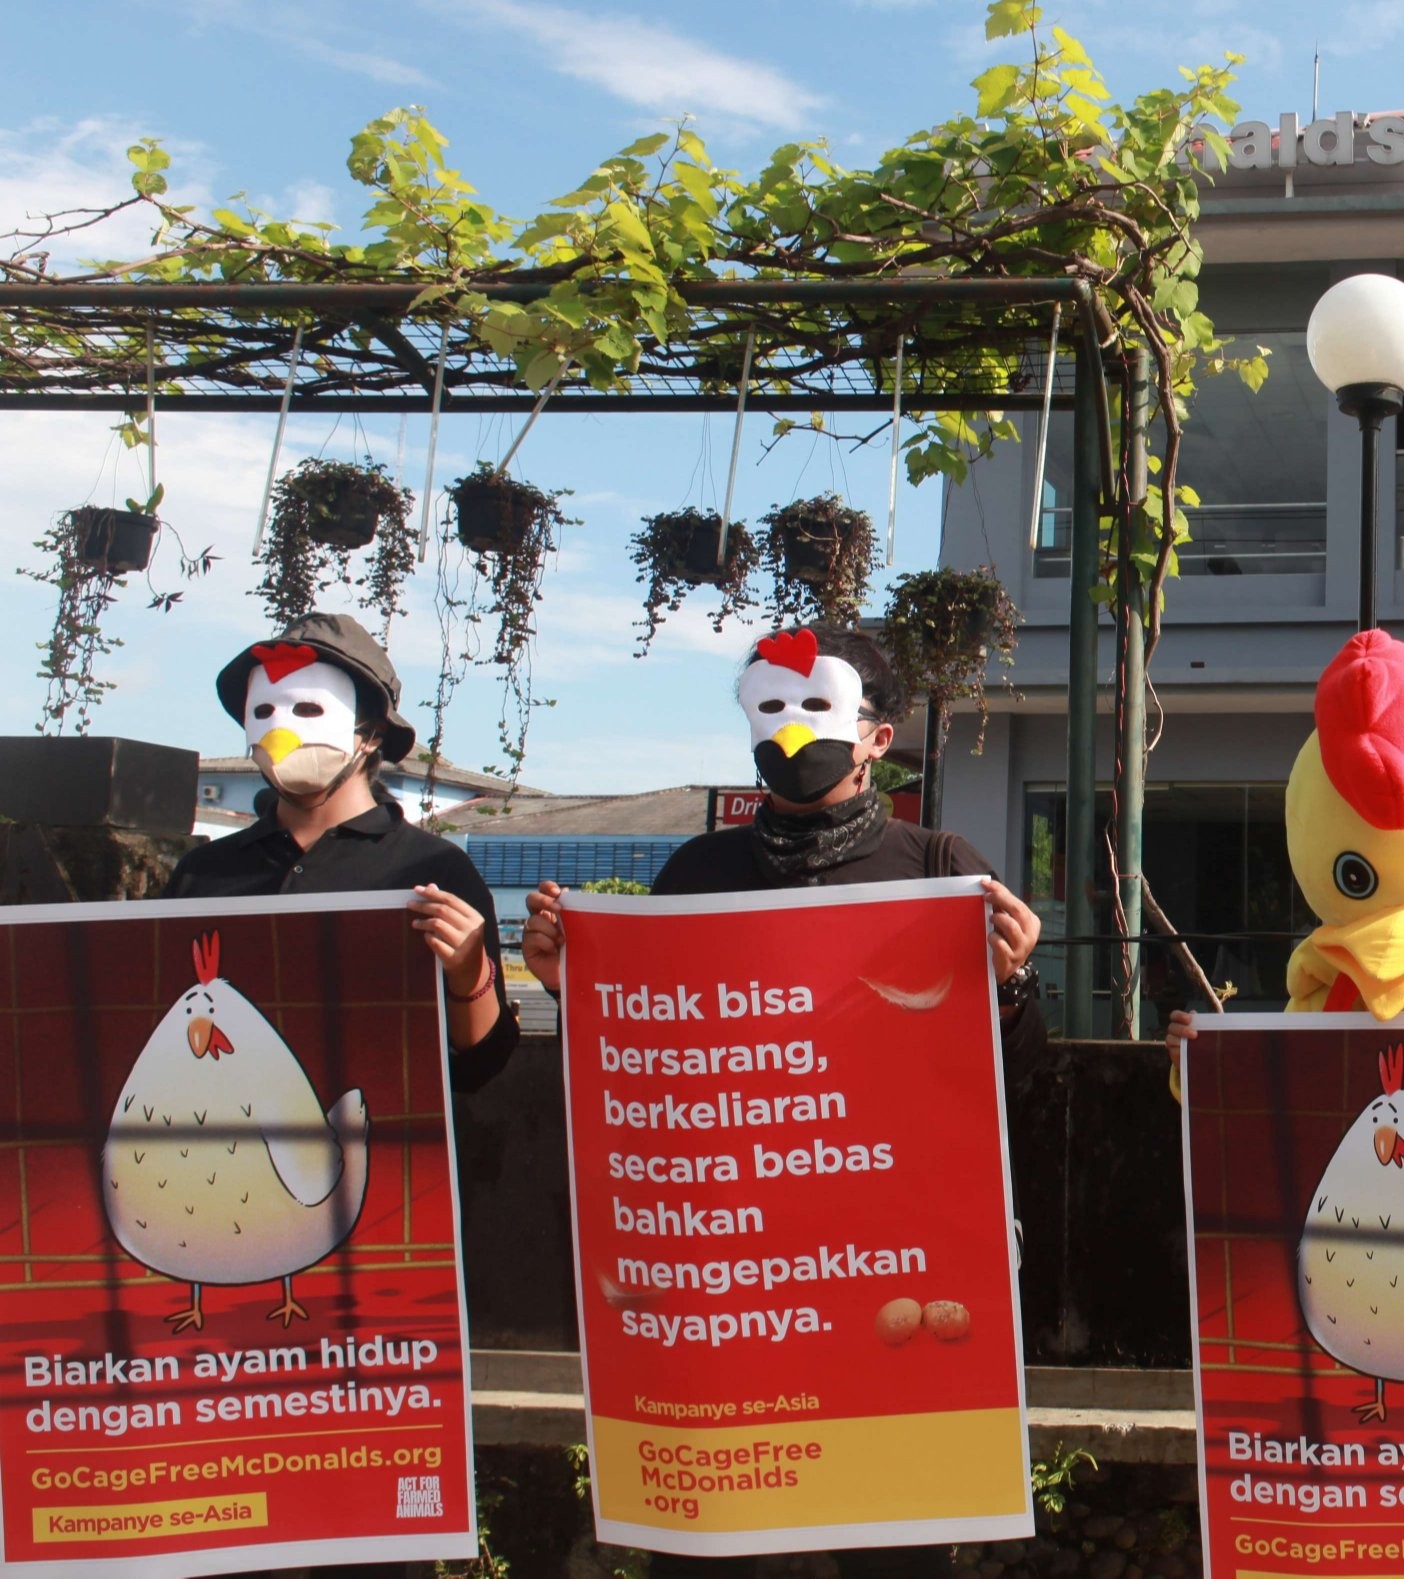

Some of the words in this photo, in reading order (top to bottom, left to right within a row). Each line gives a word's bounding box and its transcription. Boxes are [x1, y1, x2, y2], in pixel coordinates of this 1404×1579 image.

[730, 796, 763, 816] Dri
[595, 984, 704, 1020] Tidak
[718, 981, 813, 1018] bisa
[600, 1037, 827, 1075] bersarang,
[605, 1091, 846, 1129] berkeliaran
[609, 1153, 738, 1183] secara
[754, 1139, 893, 1178] bebas
[614, 1197, 763, 1235] bahkan
[618, 1244, 926, 1294] mengepakkan
[622, 1308, 831, 1346] sayapnya.
[25, 1353, 179, 1386] Biarkan
[194, 1347, 306, 1382] ayam
[321, 1335, 437, 1370] hidup
[27, 1401, 180, 1435] dengan
[196, 1381, 441, 1422] semestinya.
[635, 1396, 737, 1420] Kampanye
[743, 1393, 819, 1414] se-Asia
[638, 1440, 821, 1470] GoCageFree
[1229, 1432, 1364, 1465] Biarkan
[32, 1446, 441, 1490] GoCageFreeMcDonalds.org
[398, 1477, 417, 1490] ACT
[420, 1476, 439, 1490] FOR
[641, 1465, 798, 1491] McDonalds
[397, 1502, 443, 1518] ANIMALS
[398, 1490, 441, 1504] FARMED
[1231, 1474, 1366, 1512] dengan
[50, 1515, 163, 1535] Kampanye
[170, 1503, 251, 1526] se-Asia
